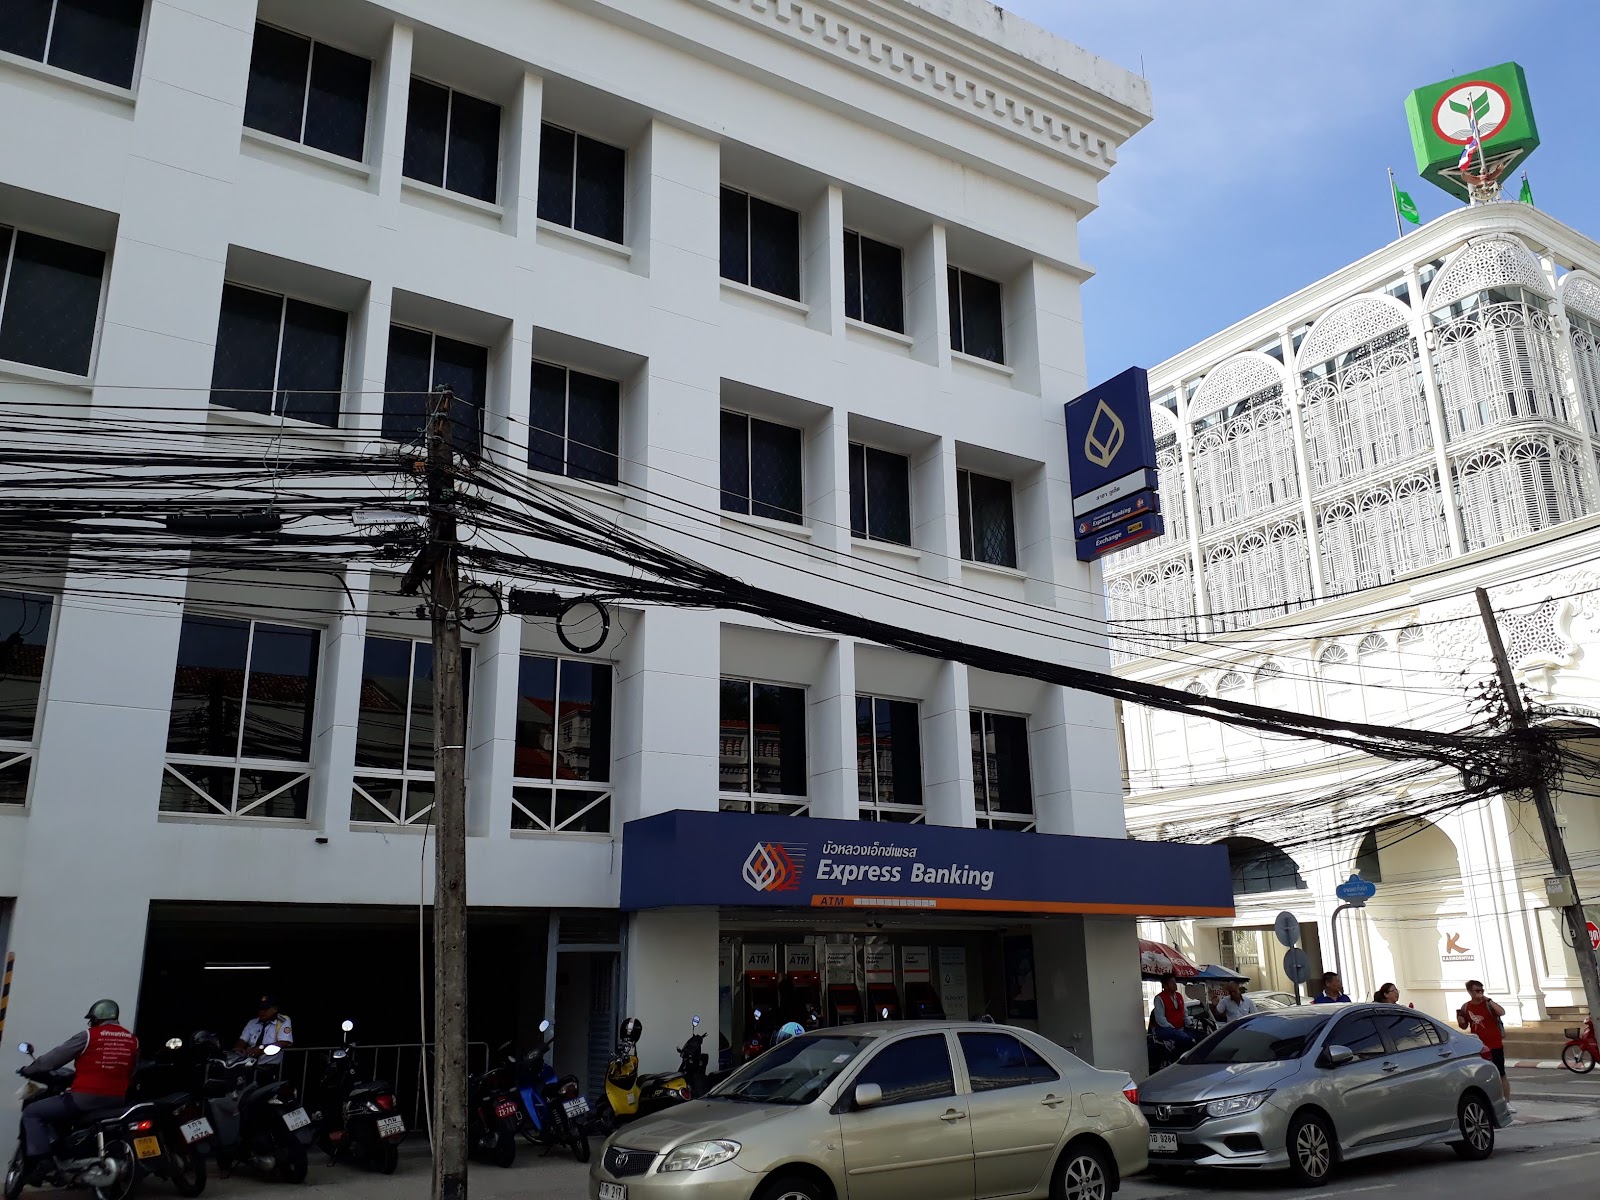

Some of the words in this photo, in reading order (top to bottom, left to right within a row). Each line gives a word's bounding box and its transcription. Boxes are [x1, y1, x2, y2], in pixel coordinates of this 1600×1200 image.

[1092, 515, 1111, 527] Express
[1111, 507, 1132, 519] Banking
[1095, 532, 1122, 547] Exchange
[822, 840, 918, 858] บัวหลวงเอ็กซ์เพรส
[816, 859, 902, 885] Express
[910, 862, 995, 891] Banking
[820, 896, 845, 906] ATM
[1446, 932, 1471, 954] K
[748, 955, 770, 965] ATM
[789, 956, 810, 965] ATM
